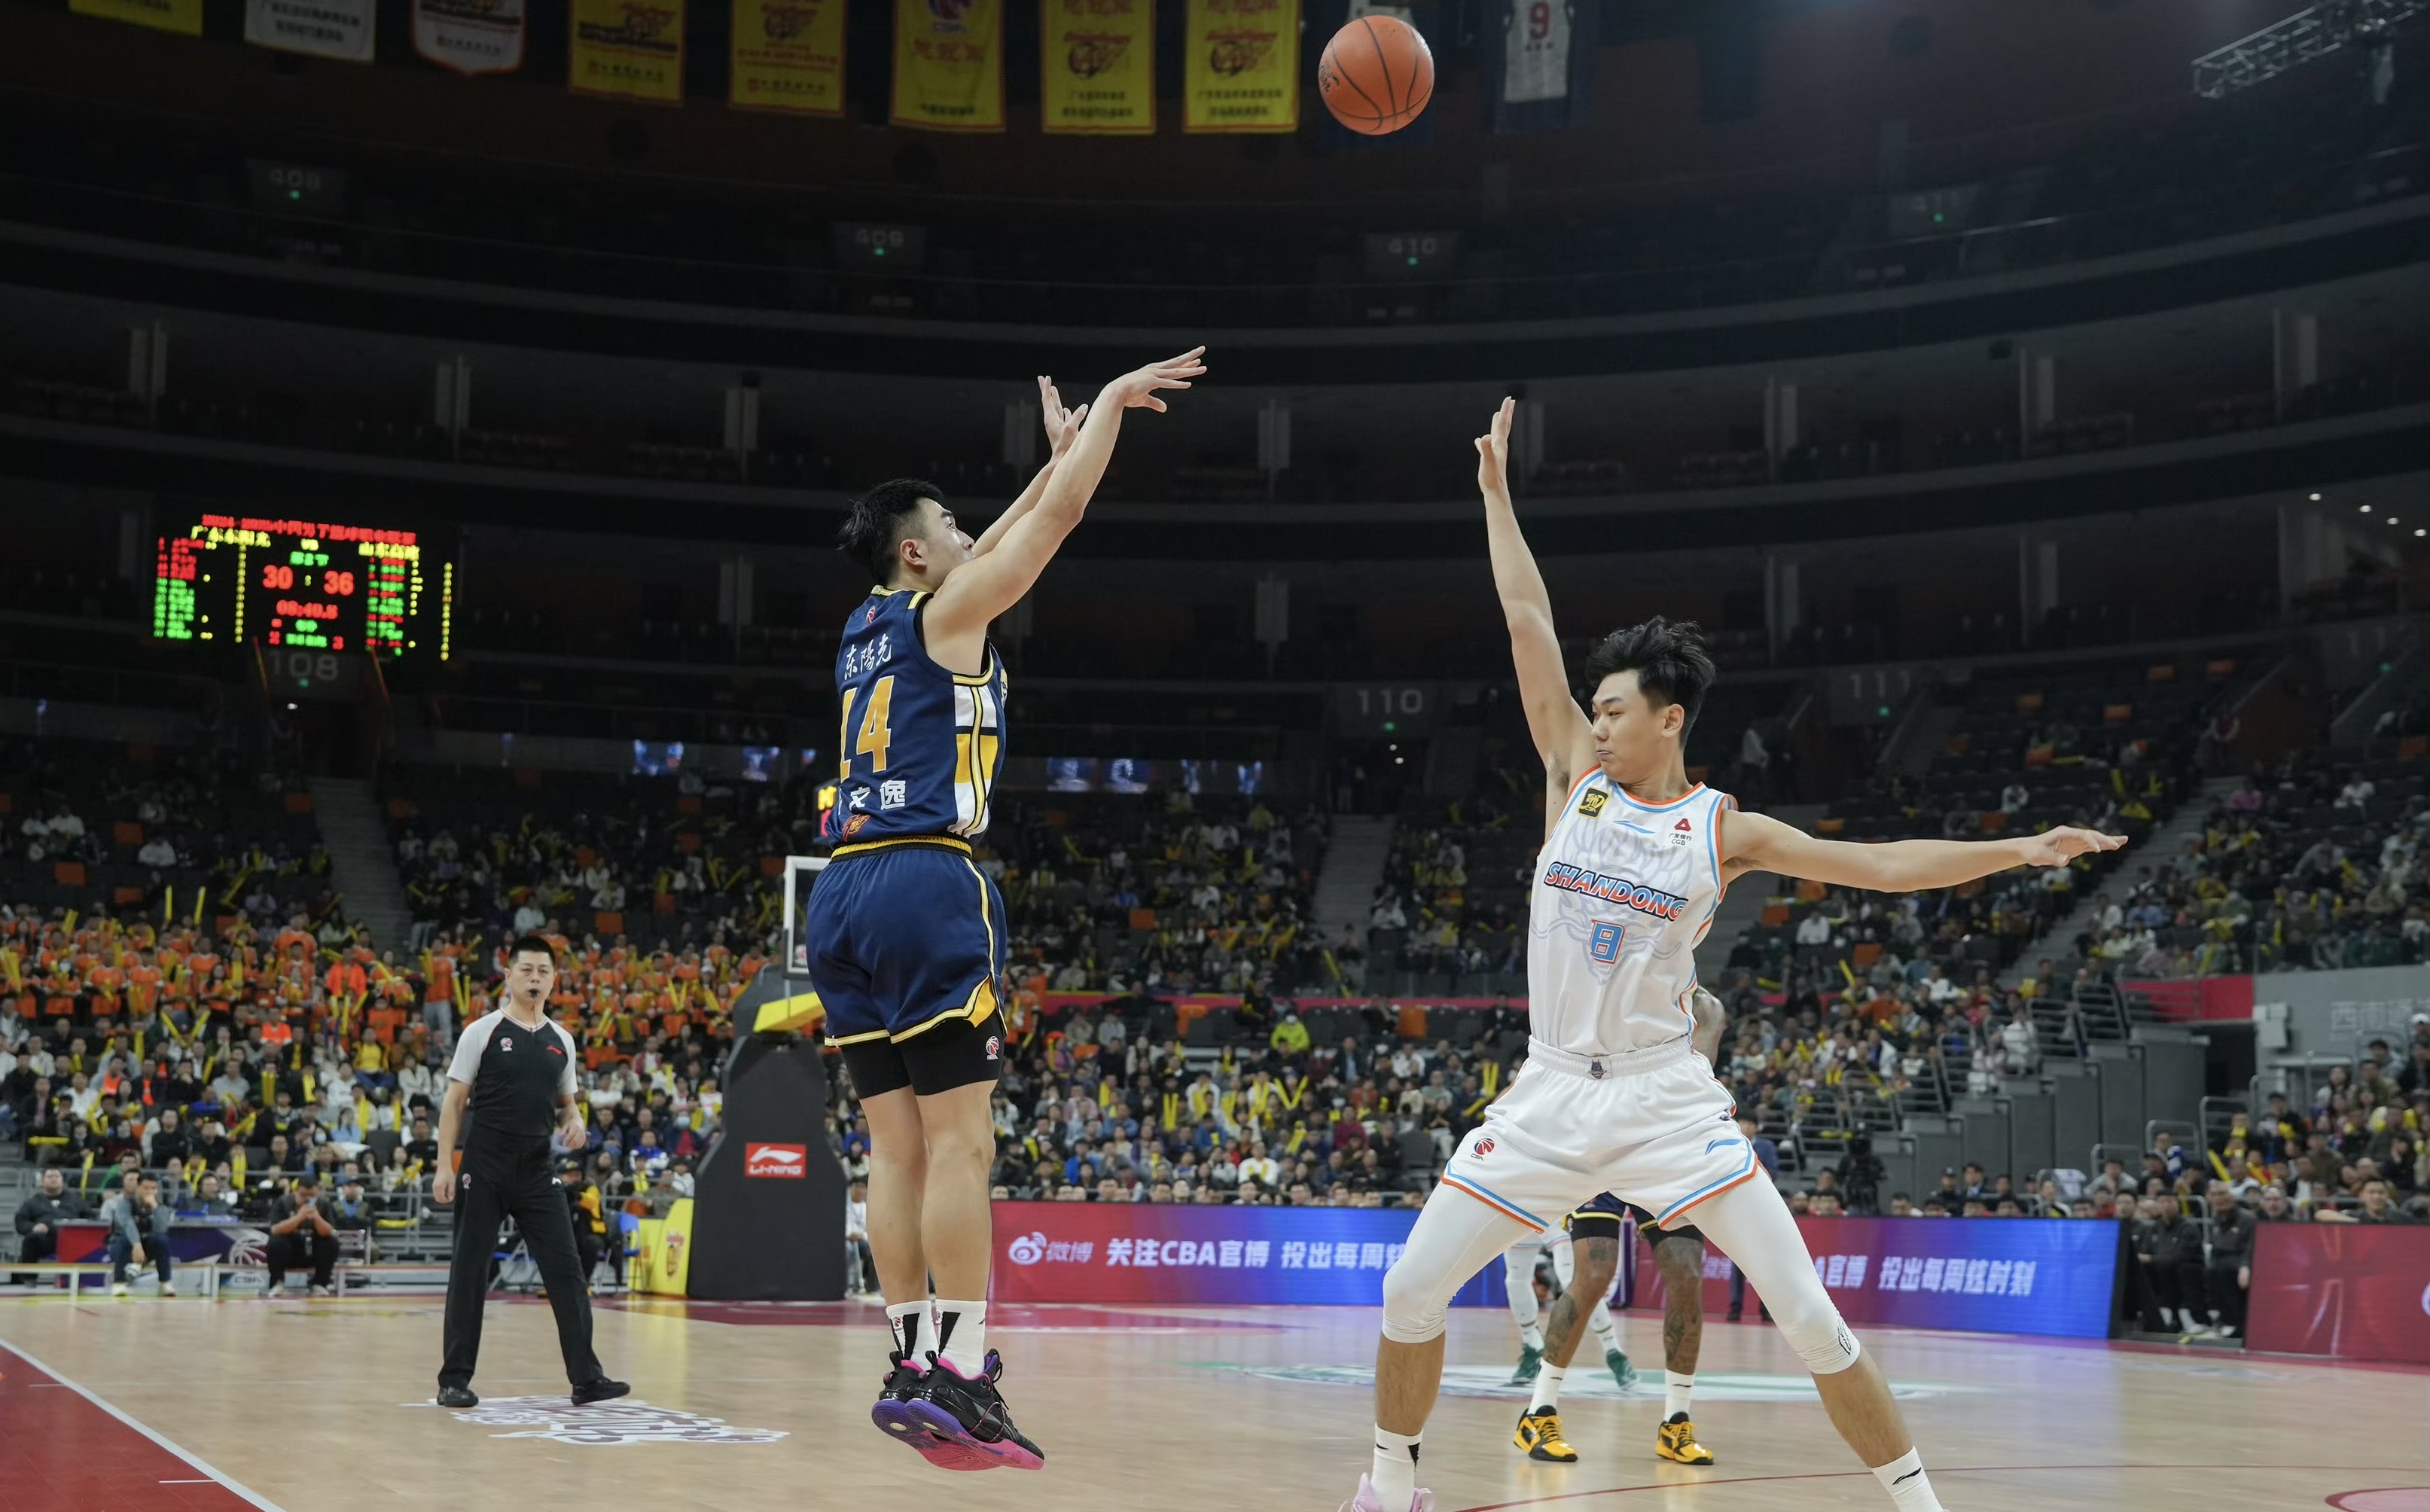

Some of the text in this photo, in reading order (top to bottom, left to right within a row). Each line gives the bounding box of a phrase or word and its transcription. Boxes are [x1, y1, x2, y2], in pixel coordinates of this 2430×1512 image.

[1529, 1, 1550, 39] 9
[1388, 238, 1437, 255] 410
[262, 564, 294, 590] 30
[323, 570, 355, 596] 36
[269, 652, 339, 681] 108
[1358, 688, 1423, 715] 110
[840, 675, 895, 783] 14
[837, 779, 907, 816] 文逸
[1669, 833, 1692, 841] 广发银行
[1544, 862, 1688, 921] SHANDONG
[1590, 919, 1626, 965] 8
[2330, 998, 2430, 1030] 西南通
[1045, 1241, 1094, 1263] 微博
[1106, 1238, 1271, 1268] 关注CBA官博
